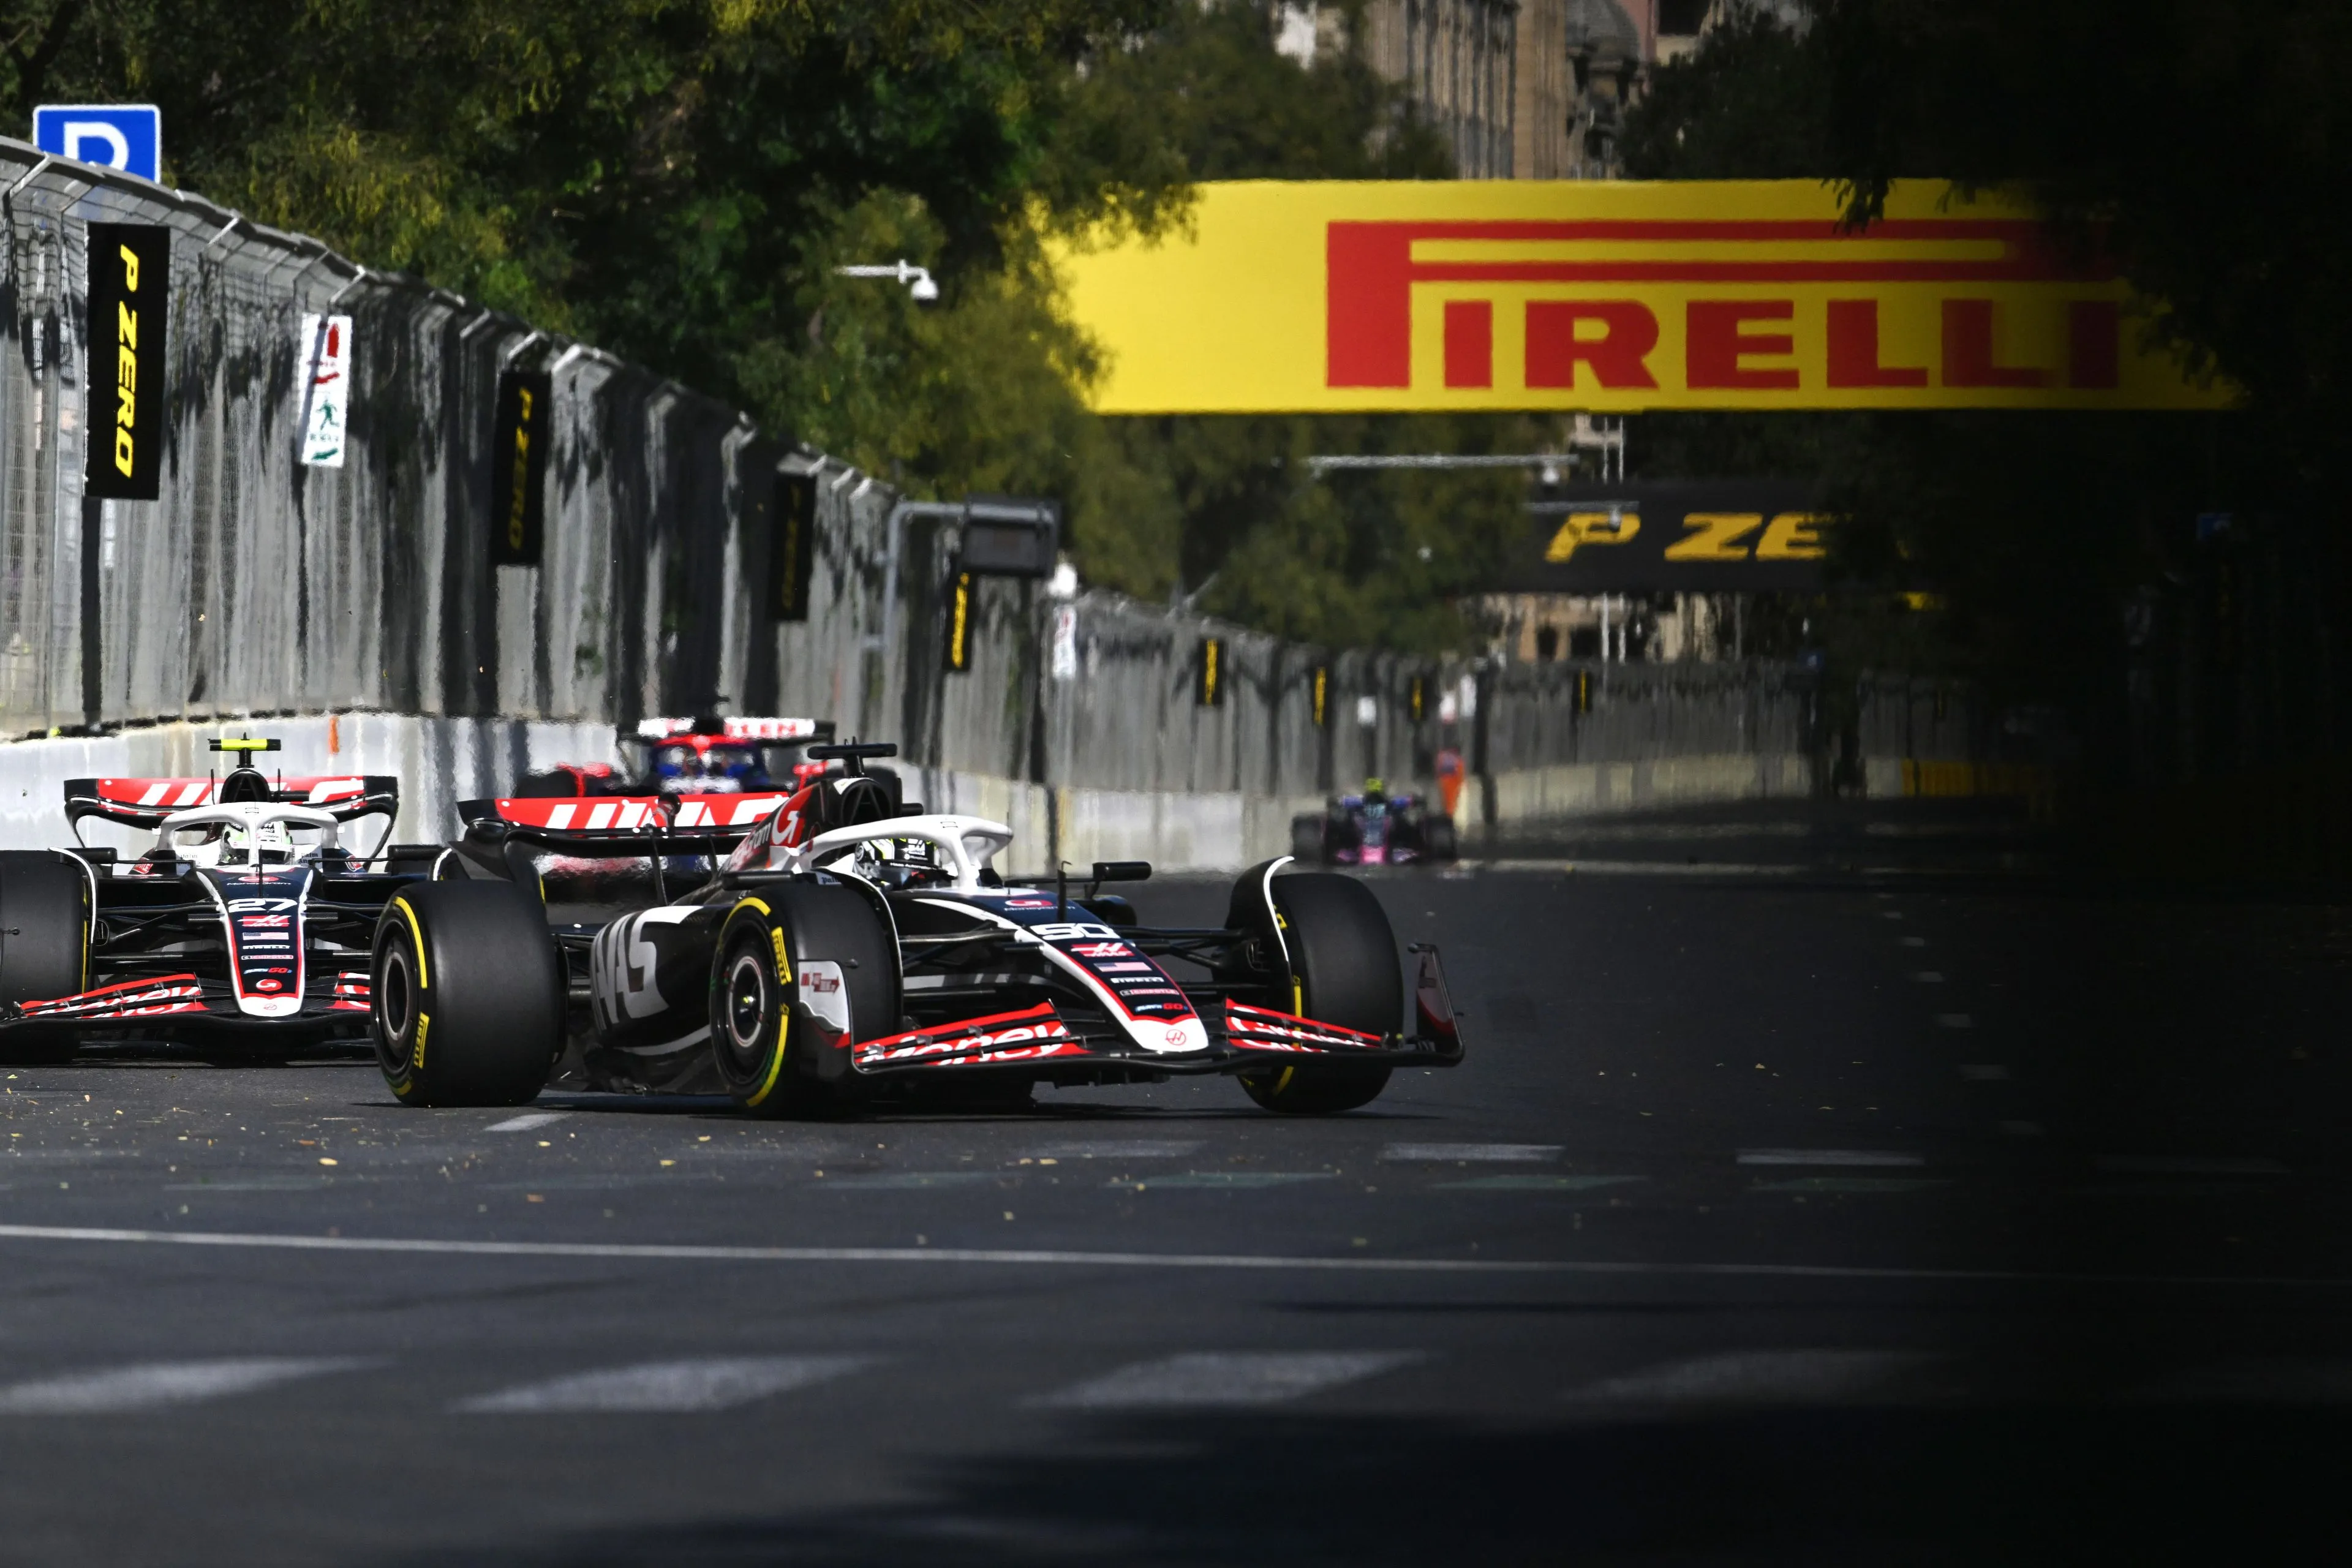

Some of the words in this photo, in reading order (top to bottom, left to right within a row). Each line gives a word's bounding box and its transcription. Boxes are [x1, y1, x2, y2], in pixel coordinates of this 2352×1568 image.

[121, 244, 140, 293] P
[1327, 221, 2119, 390] PIRELLI
[115, 301, 137, 478] ZERO
[1544, 512, 1642, 562] P
[1664, 511, 1828, 562] ZE
[227, 898, 298, 913] 27
[771, 925, 792, 986] PIRELLI
[1030, 922, 1121, 941] 50
